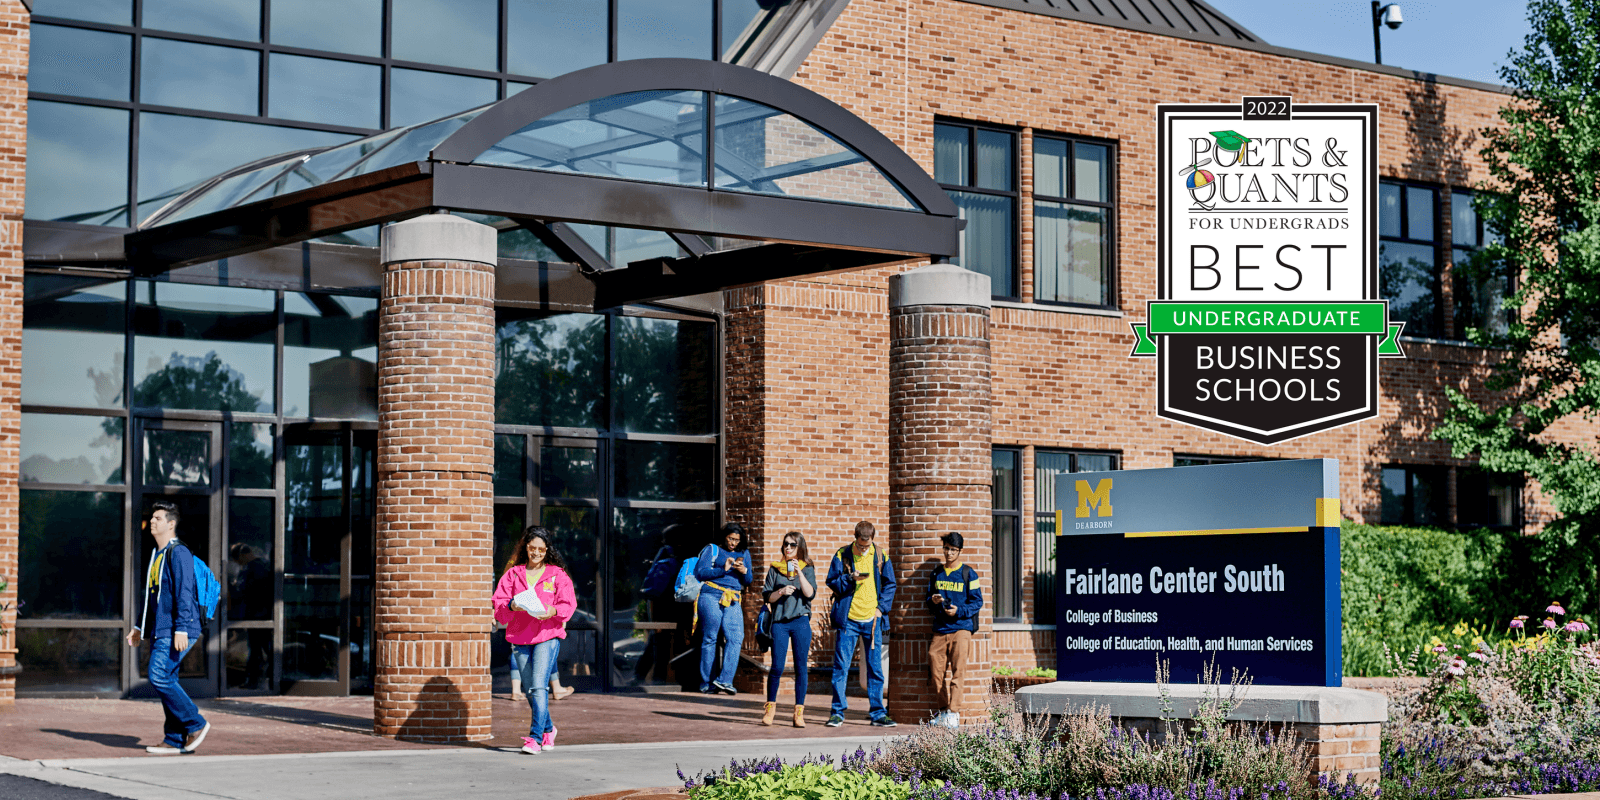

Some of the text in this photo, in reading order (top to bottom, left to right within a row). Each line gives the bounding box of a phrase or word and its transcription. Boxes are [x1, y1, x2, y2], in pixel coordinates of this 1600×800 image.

[1075, 478, 1113, 518] M
[1075, 521, 1113, 529] DEARBORN
[935, 580, 965, 592] ICHIGAN
[1065, 563, 1286, 595] Fairlane Center South
[1065, 609, 1159, 626] College of Business
[1065, 636, 1314, 653] College of Education, Health, and Human Services
